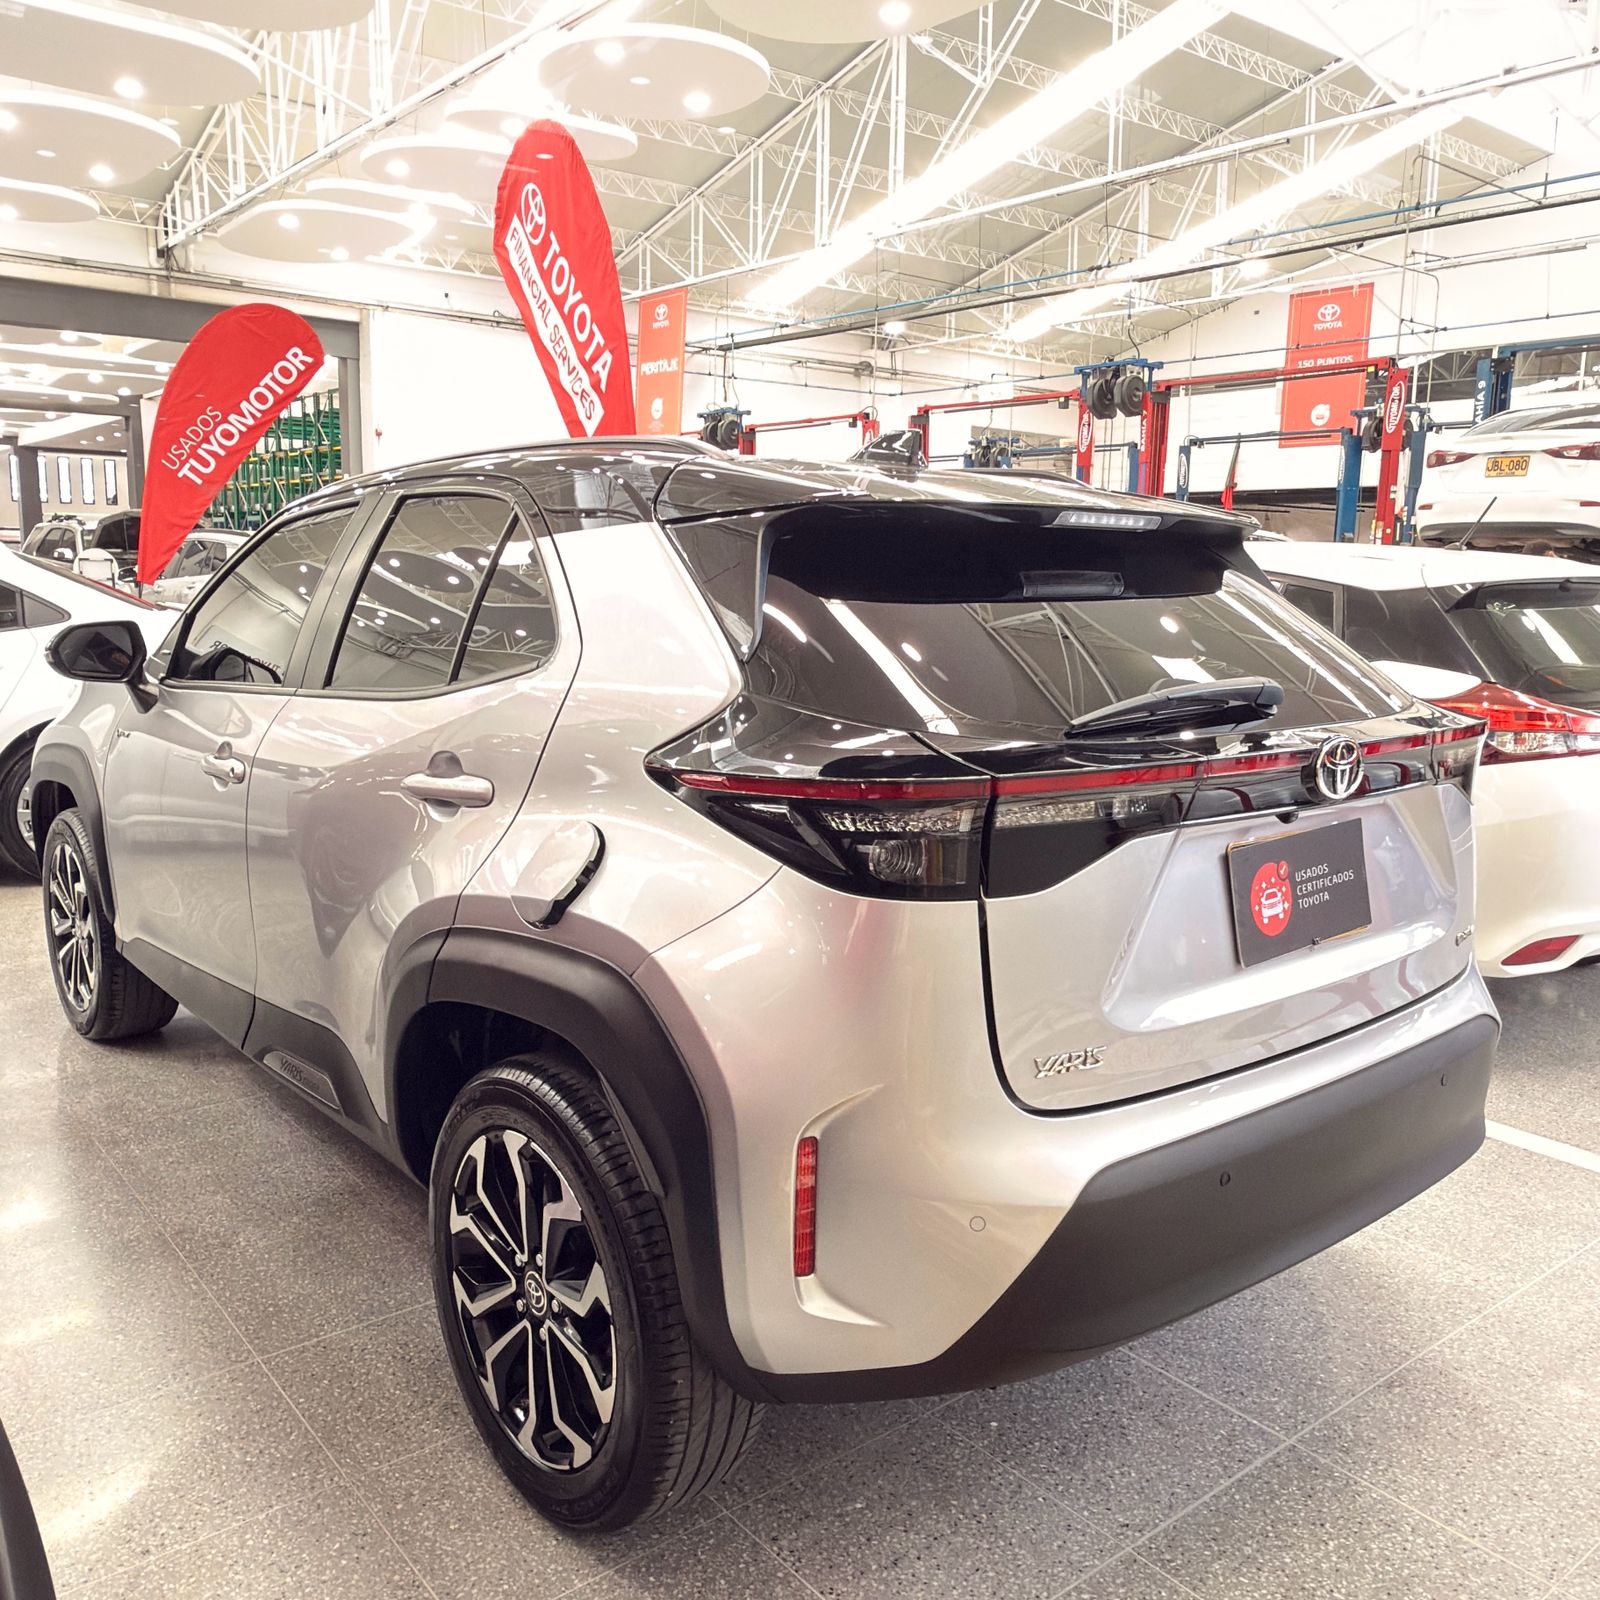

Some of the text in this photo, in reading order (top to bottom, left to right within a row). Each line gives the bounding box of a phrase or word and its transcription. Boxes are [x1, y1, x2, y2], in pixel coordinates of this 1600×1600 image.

[508, 227, 596, 422] FINANCIAL SERVICES
[543, 231, 613, 392] TOYOTA
[1313, 321, 1343, 331] TOYOTA
[1297, 354, 1354, 369] 150 PUNTOS
[177, 345, 314, 486] TUYOMOTOR
[161, 405, 222, 470] USADOS
[1295, 863, 1328, 881] USADOS
[1296, 870, 1354, 895] CERTIFICADOS
[1298, 891, 1329, 909] TOYOTA
[1034, 1046, 1107, 1079] YARIS
